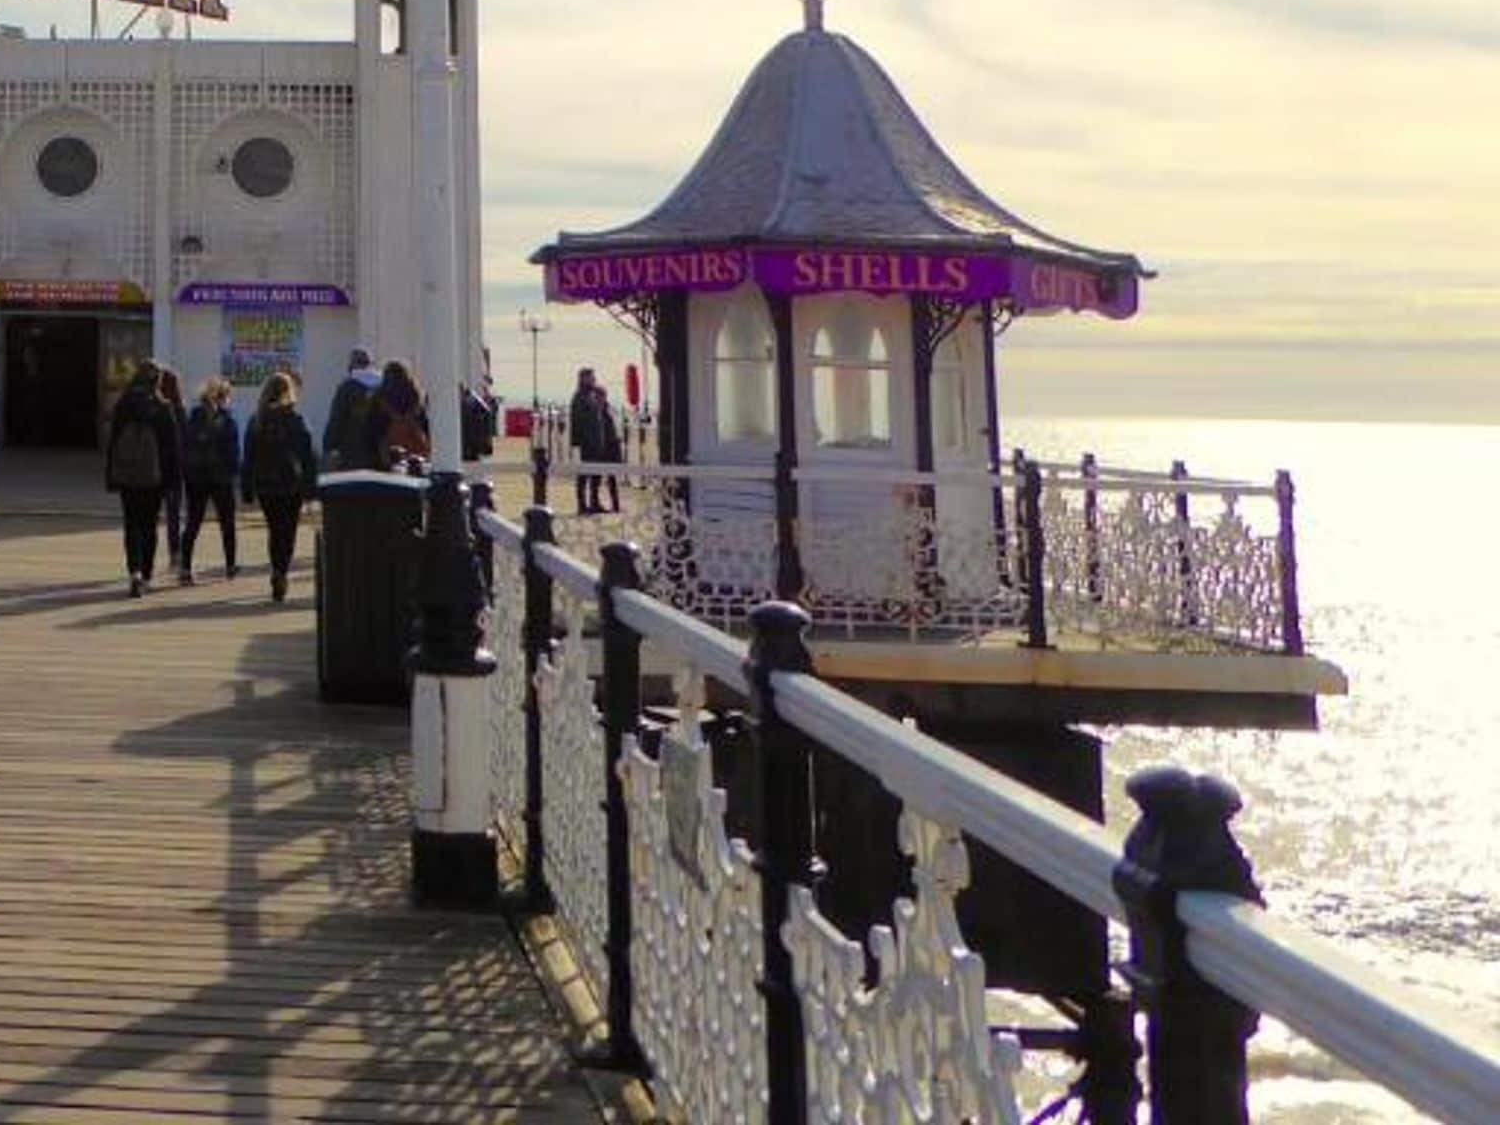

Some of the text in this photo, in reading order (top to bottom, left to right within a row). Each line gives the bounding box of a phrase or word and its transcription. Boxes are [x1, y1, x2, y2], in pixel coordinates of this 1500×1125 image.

[561, 248, 743, 291] SOUVENIRS
[793, 253, 968, 292] SHELLS
[1030, 264, 1098, 302] GIFTS
